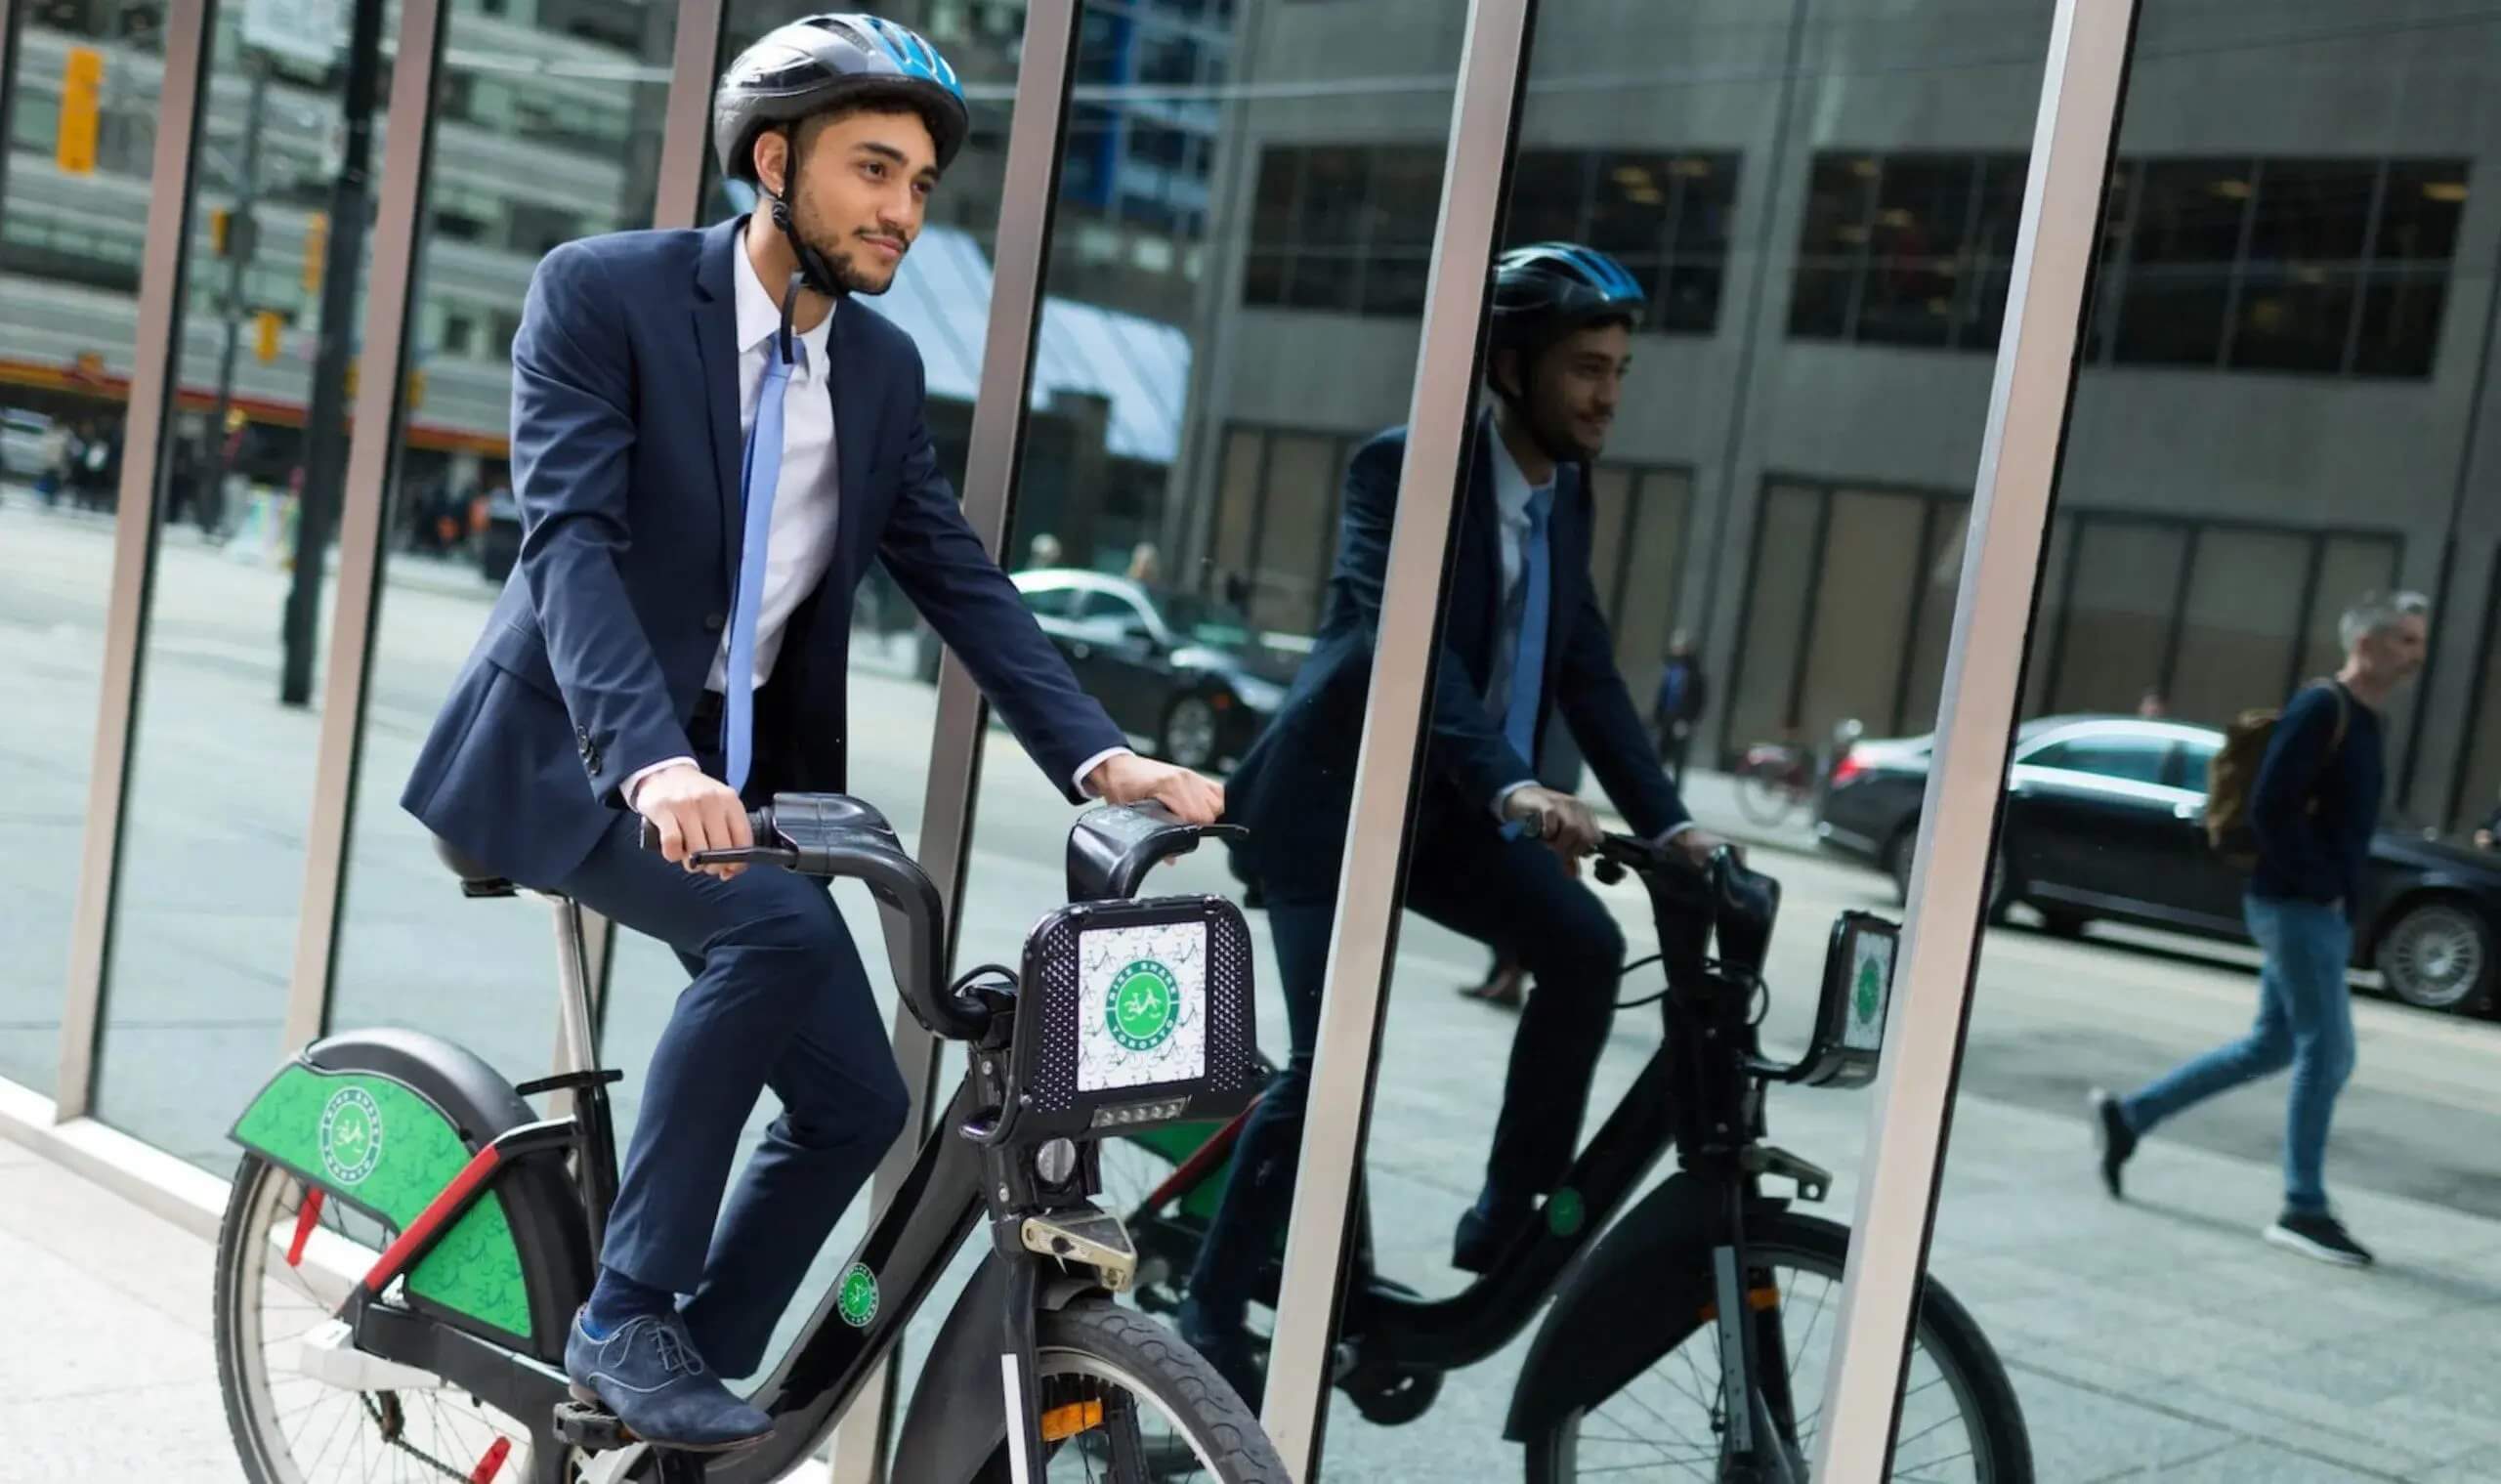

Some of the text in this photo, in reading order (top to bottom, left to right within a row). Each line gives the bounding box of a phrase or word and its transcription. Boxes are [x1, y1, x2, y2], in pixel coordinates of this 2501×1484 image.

[1109, 962, 1176, 1001] BIKE SHARE
[1112, 1019, 1173, 1049] TORONTO
